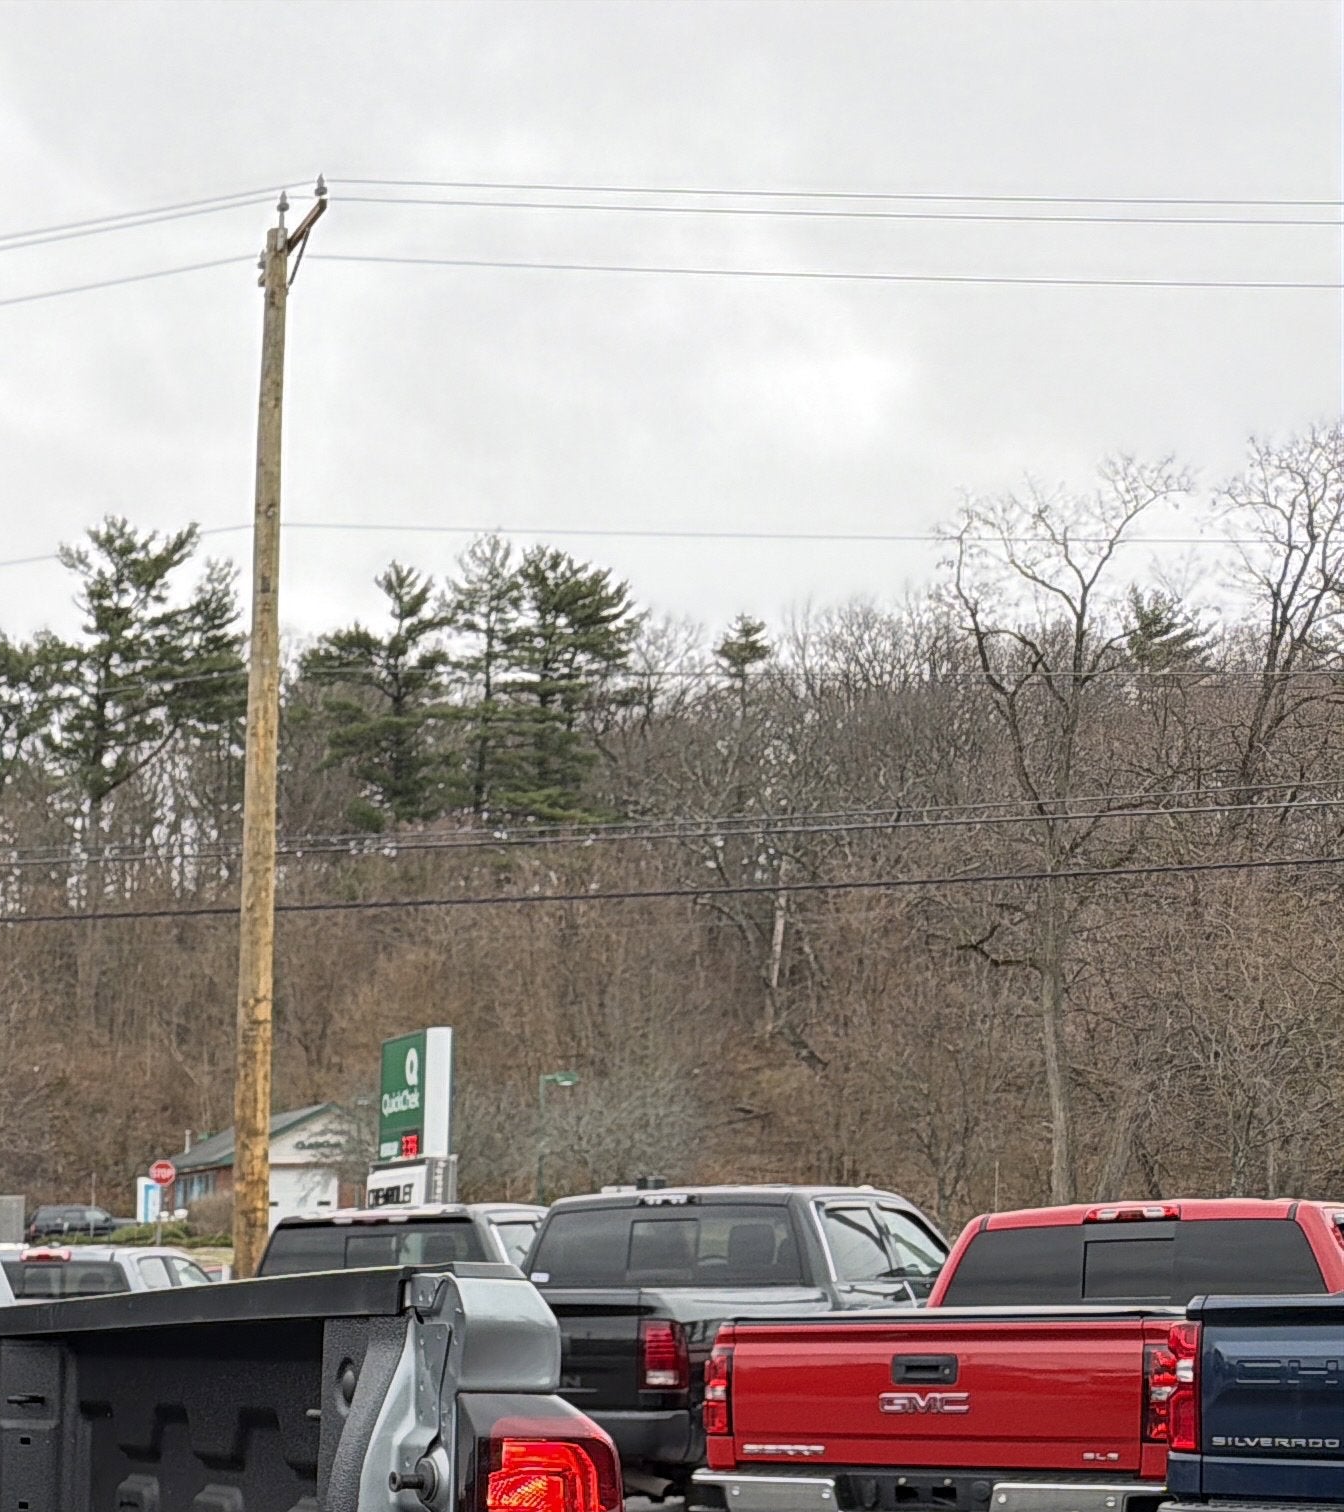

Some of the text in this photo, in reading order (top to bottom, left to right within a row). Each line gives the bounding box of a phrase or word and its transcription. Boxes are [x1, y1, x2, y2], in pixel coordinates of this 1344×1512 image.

[405, 1048, 418, 1086] Q
[382, 1088, 420, 1117] QuickChek
[152, 1167, 173, 1179] STOP
[879, 1392, 970, 1413] GMC
[1212, 1436, 1340, 1448] SILVERADO
